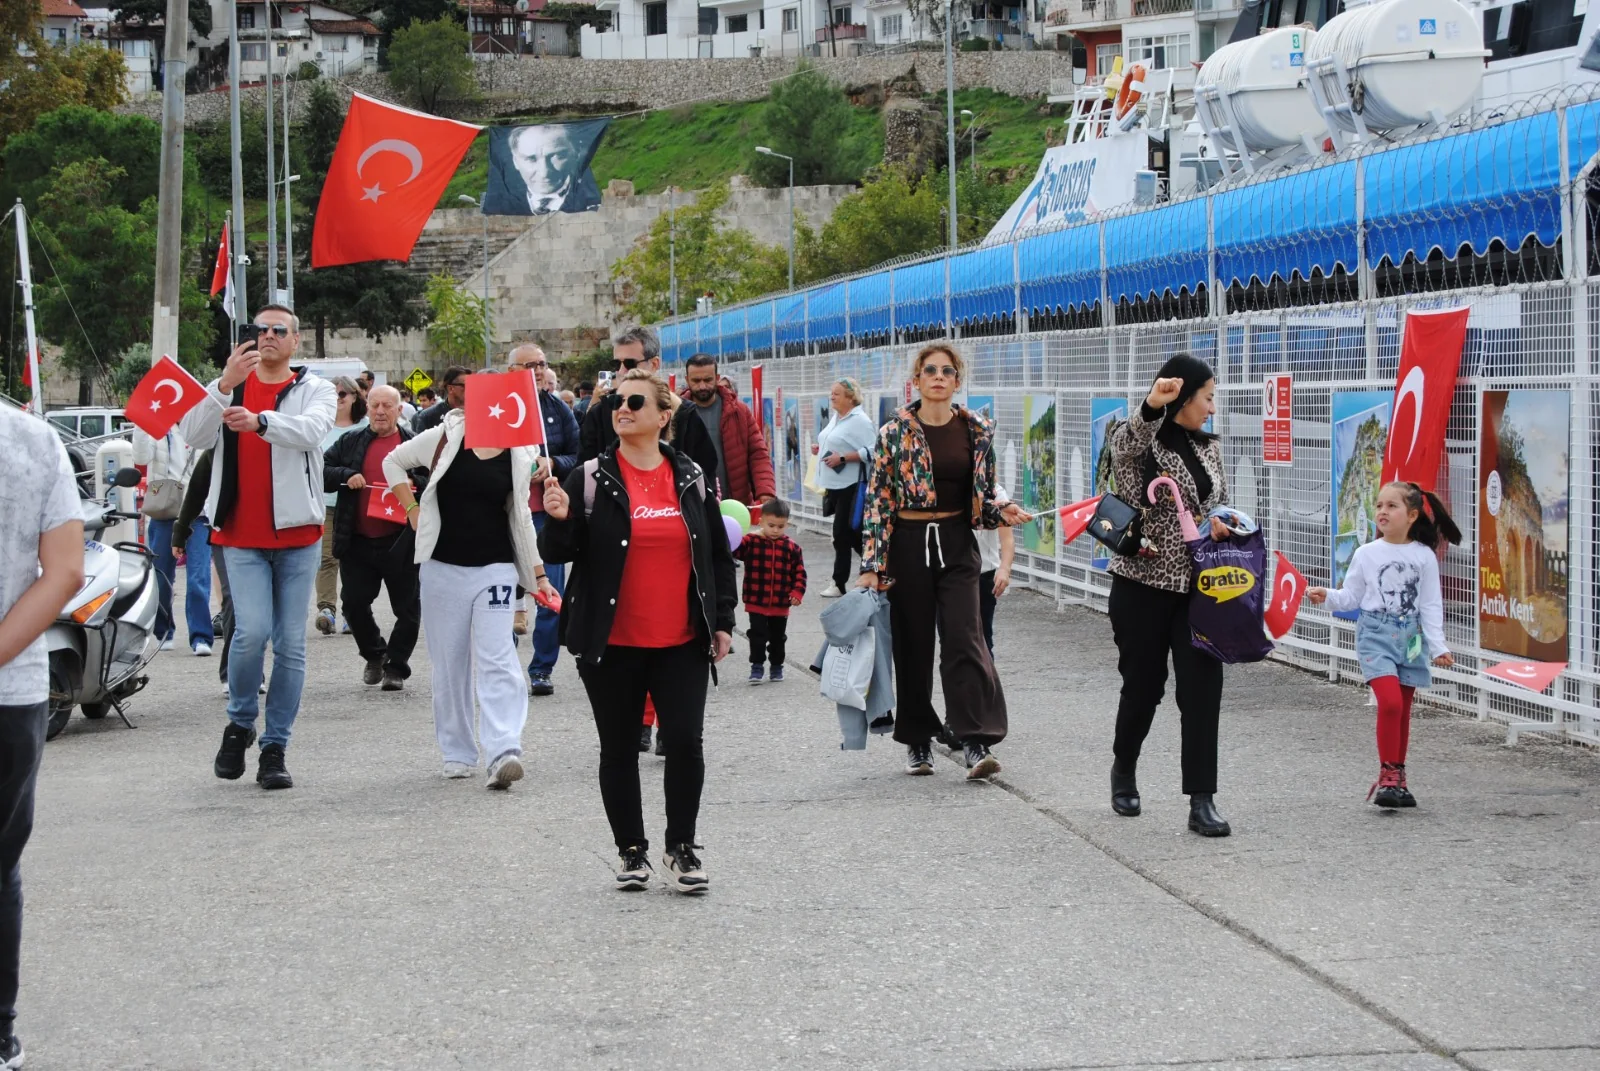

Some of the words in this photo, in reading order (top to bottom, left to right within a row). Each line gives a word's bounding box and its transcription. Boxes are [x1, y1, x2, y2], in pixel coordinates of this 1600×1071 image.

[1293, 35, 1299, 47] 3
[1200, 569, 1249, 591] gratis
[1480, 567, 1501, 590] Tlos
[487, 585, 512, 605] 17
[1480, 593, 1508, 618] Antik
[1509, 597, 1534, 622] Kent
